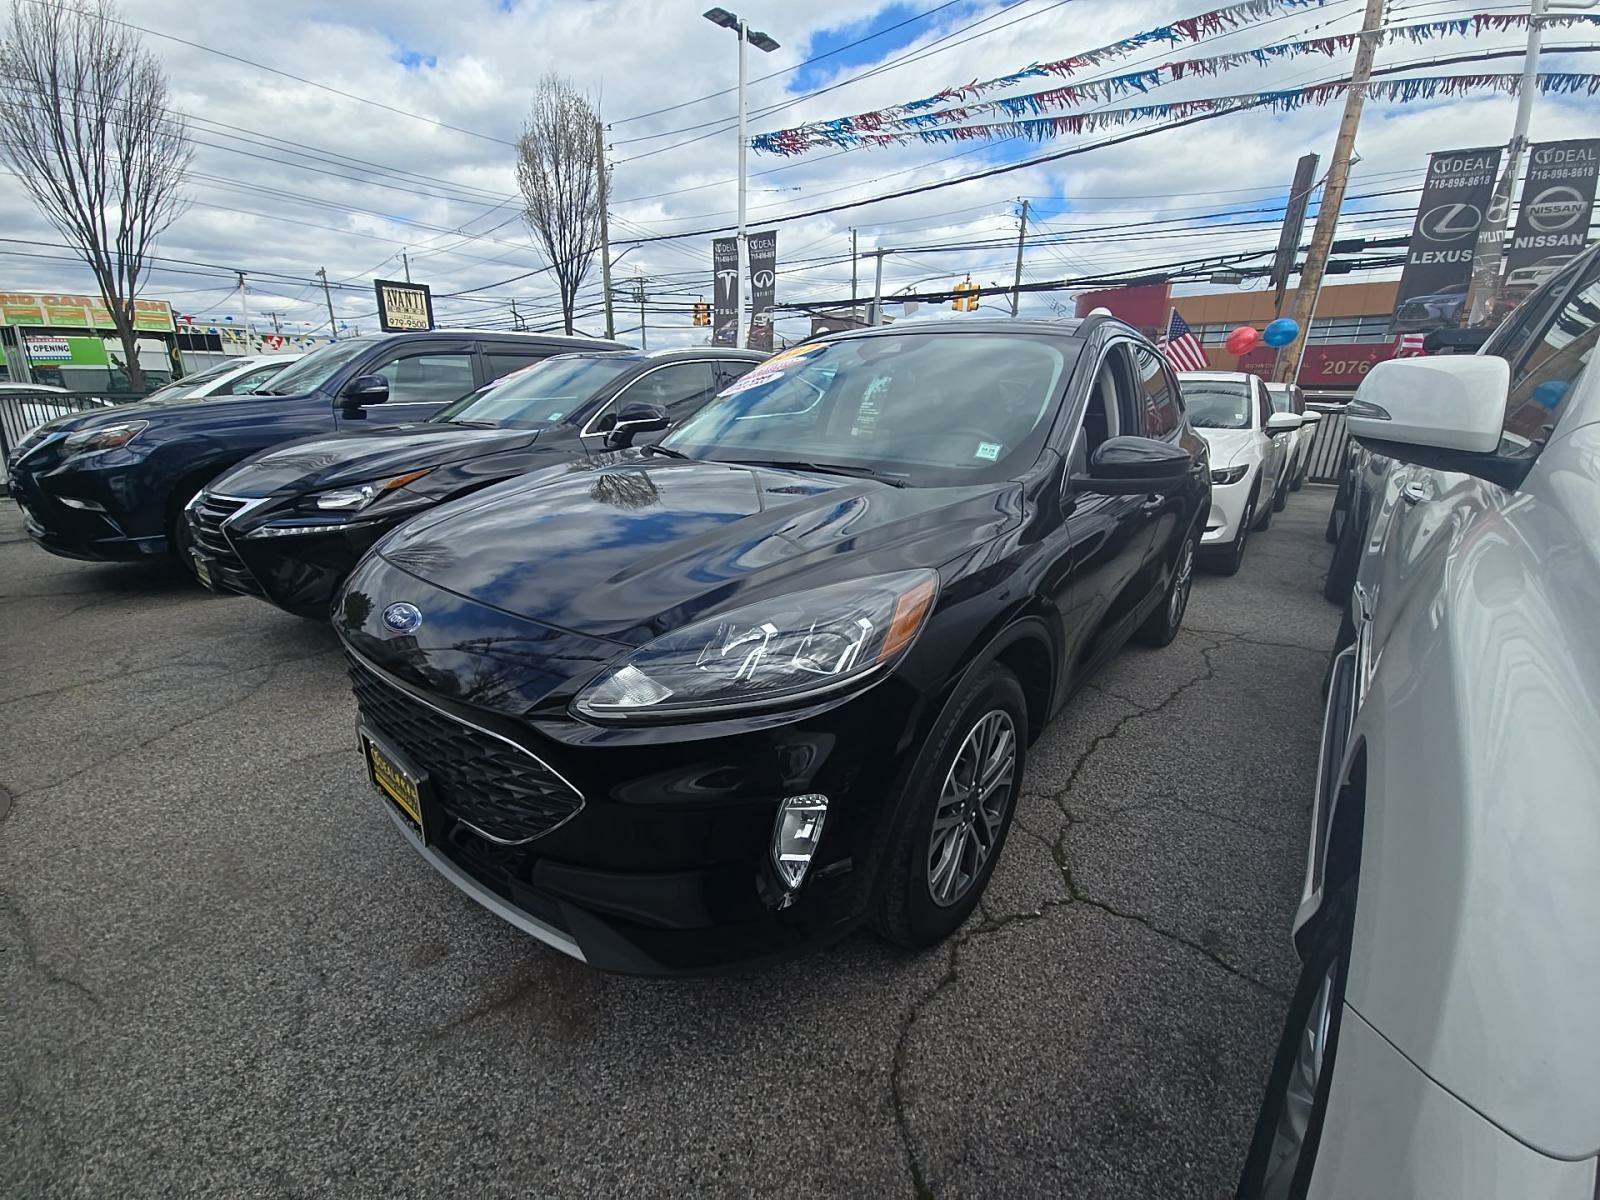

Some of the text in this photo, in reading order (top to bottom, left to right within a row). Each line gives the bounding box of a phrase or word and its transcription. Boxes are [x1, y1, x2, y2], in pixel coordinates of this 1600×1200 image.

[1555, 149, 1597, 162] DEAL
[1453, 157, 1495, 171] DEAL
[1531, 166, 1594, 180] 718-898-8618
[1429, 175, 1491, 189] 718-898-8618
[1530, 204, 1581, 214] NISSAN
[1514, 233, 1584, 249] NISSAN
[1410, 249, 1473, 265] LEXUS
[387, 289, 424, 309] AVANTI
[389, 318, 427, 328] 979-9500
[33, 344, 70, 352] OPENING
[1321, 360, 1370, 375] 2076
